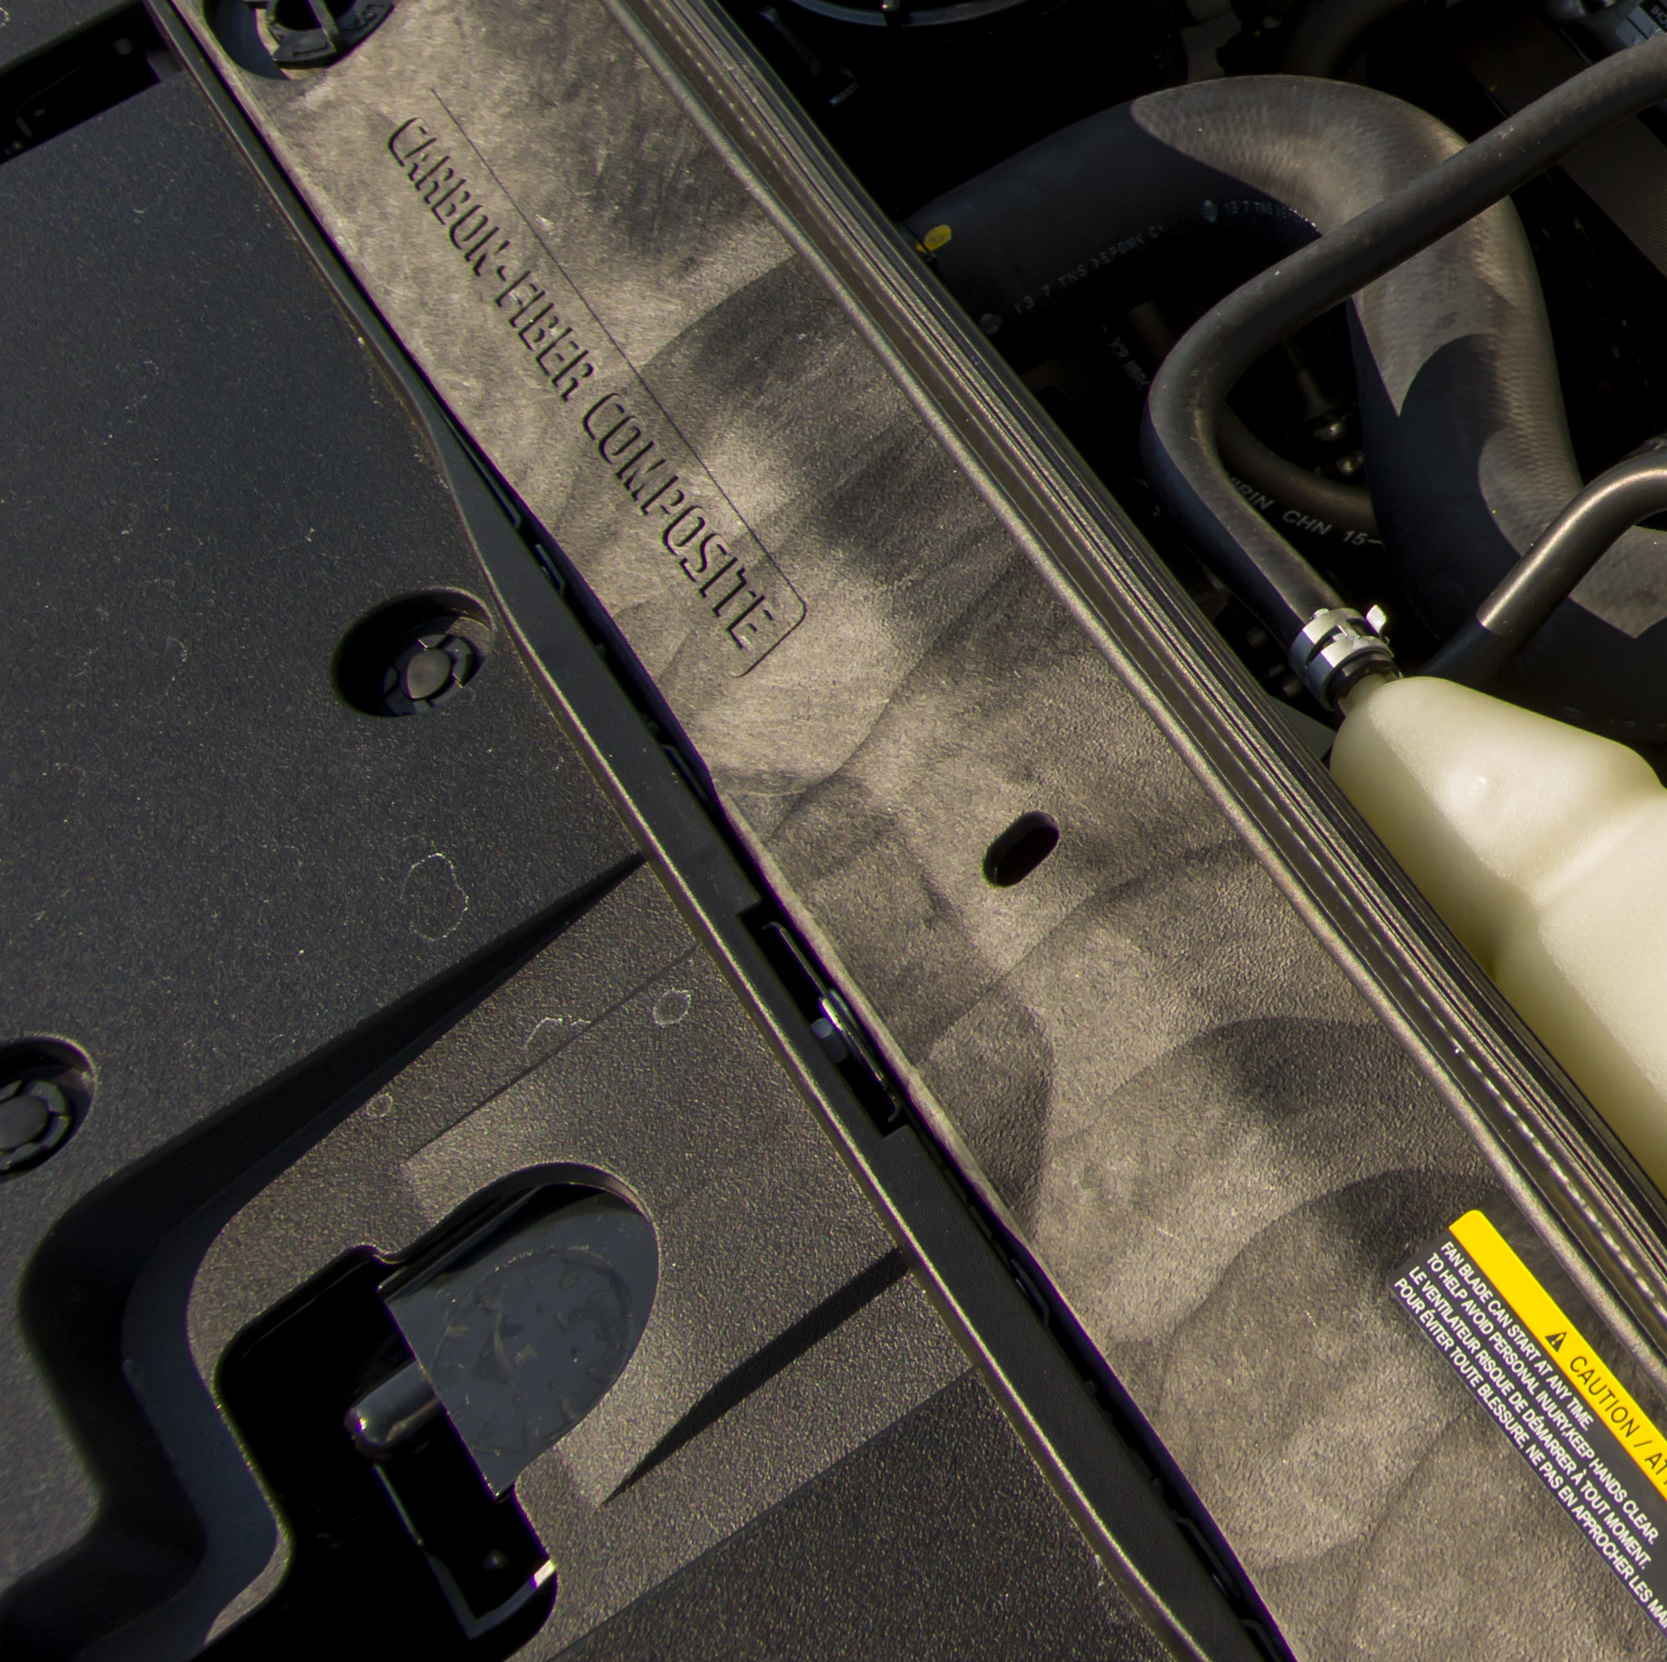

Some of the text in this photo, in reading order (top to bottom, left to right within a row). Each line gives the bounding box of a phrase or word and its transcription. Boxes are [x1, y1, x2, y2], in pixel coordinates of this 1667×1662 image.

[387, 116, 775, 649] CARBON-FIBER COMPOSITE
[1394, 1278, 1425, 1314] POUR
[1419, 1309, 1455, 1352] ÉVITER
[1450, 1346, 1484, 1388] TOUTE
[1477, 1384, 1530, 1450] BLESSURE,
[1525, 1444, 1546, 1466] NE
[1539, 1460, 1564, 1490] PAS
[1558, 1485, 1578, 1508] EN
[1571, 1501, 1636, 1581] APPROCHER
[1628, 1575, 1653, 1604] LES
[1409, 1266, 1652, 1570] LE VENTILATEUR RISQUE DE DÉMARRER À TOUT MOMENT.
[1427, 1252, 1444, 1272] TO
[1439, 1270, 1468, 1300] HELP
[1461, 1300, 1494, 1334] AVOID
[1489, 1331, 1540, 1395] PERSONAL
[1588, 1458, 1628, 1502] HANDS
[1622, 1500, 1659, 1545] CLEAR.
[1440, 1241, 1594, 1431] FAN BLADE CAN START AT ANY TIME.
[1569, 1355, 1640, 1438] CAUTION
